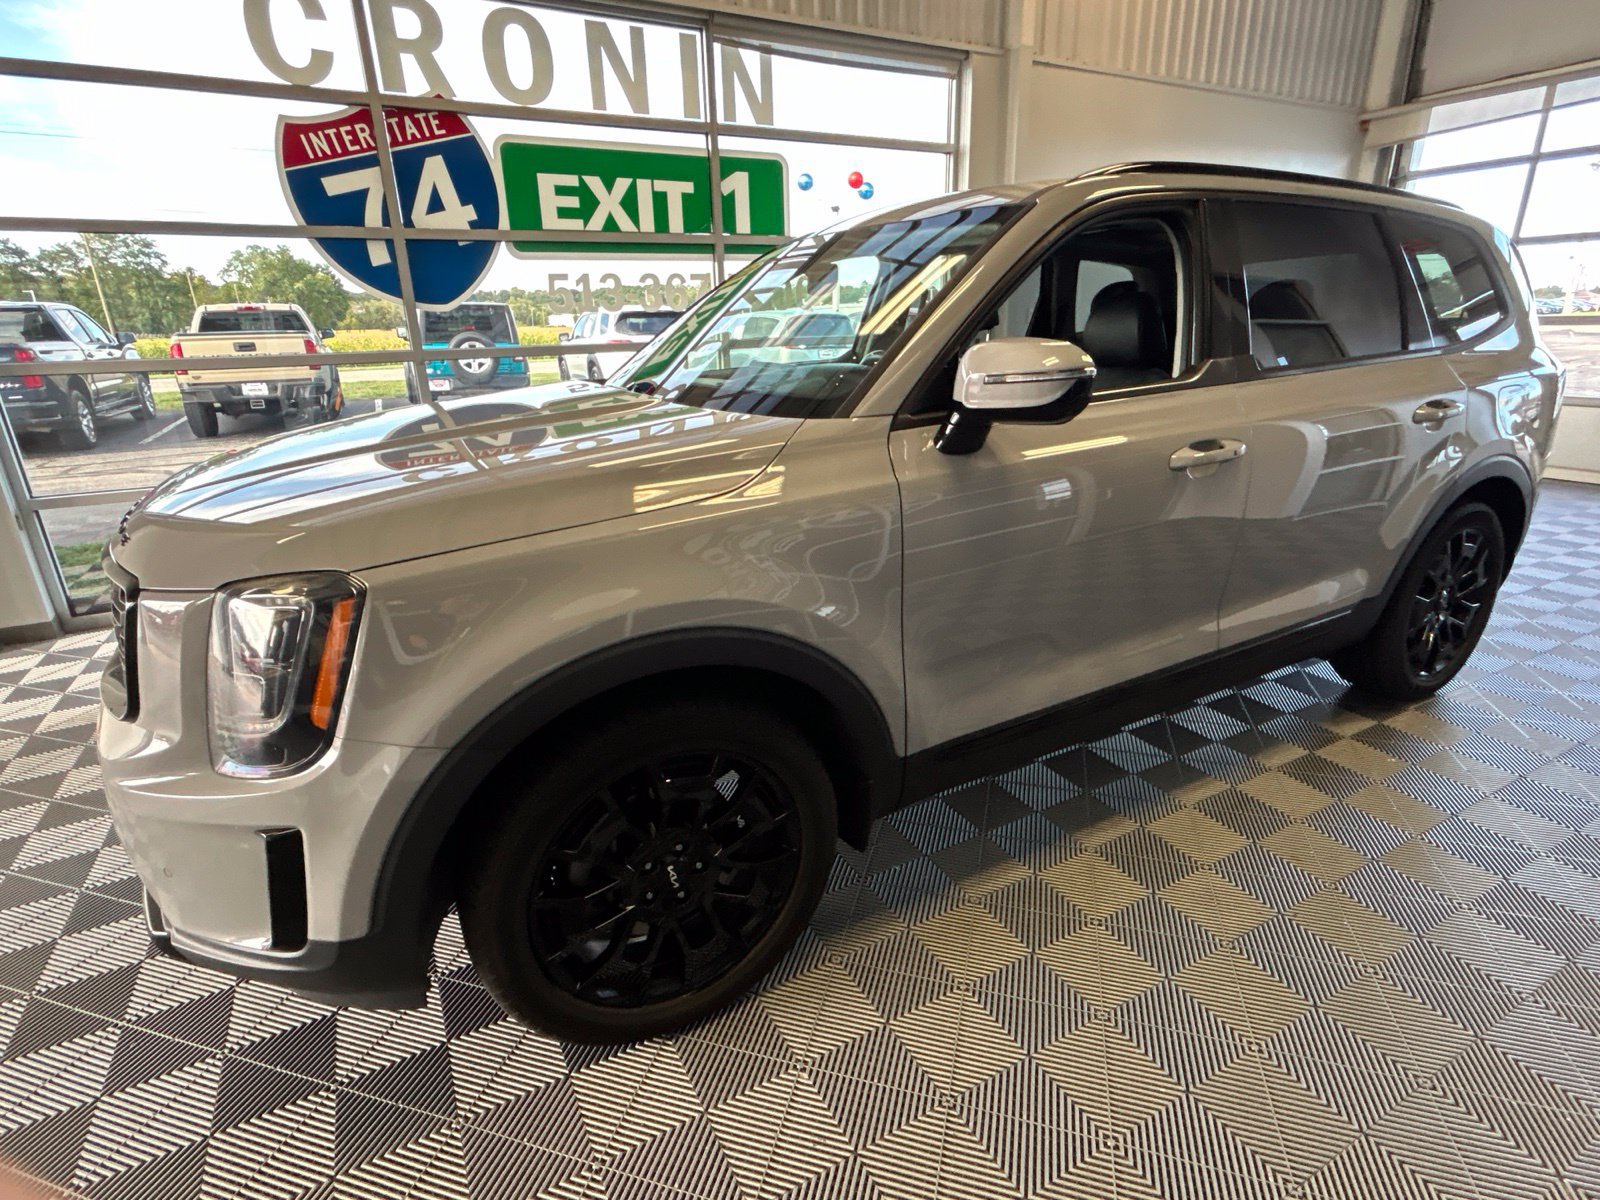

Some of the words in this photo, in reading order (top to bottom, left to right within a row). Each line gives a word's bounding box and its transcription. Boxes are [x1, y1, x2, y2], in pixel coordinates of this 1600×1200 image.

[243, 0, 774, 126] CRONIN
[300, 112, 446, 159] INTERTATE
[320, 154, 478, 267] 74
[536, 173, 694, 235] EXIT
[719, 171, 752, 235] 1
